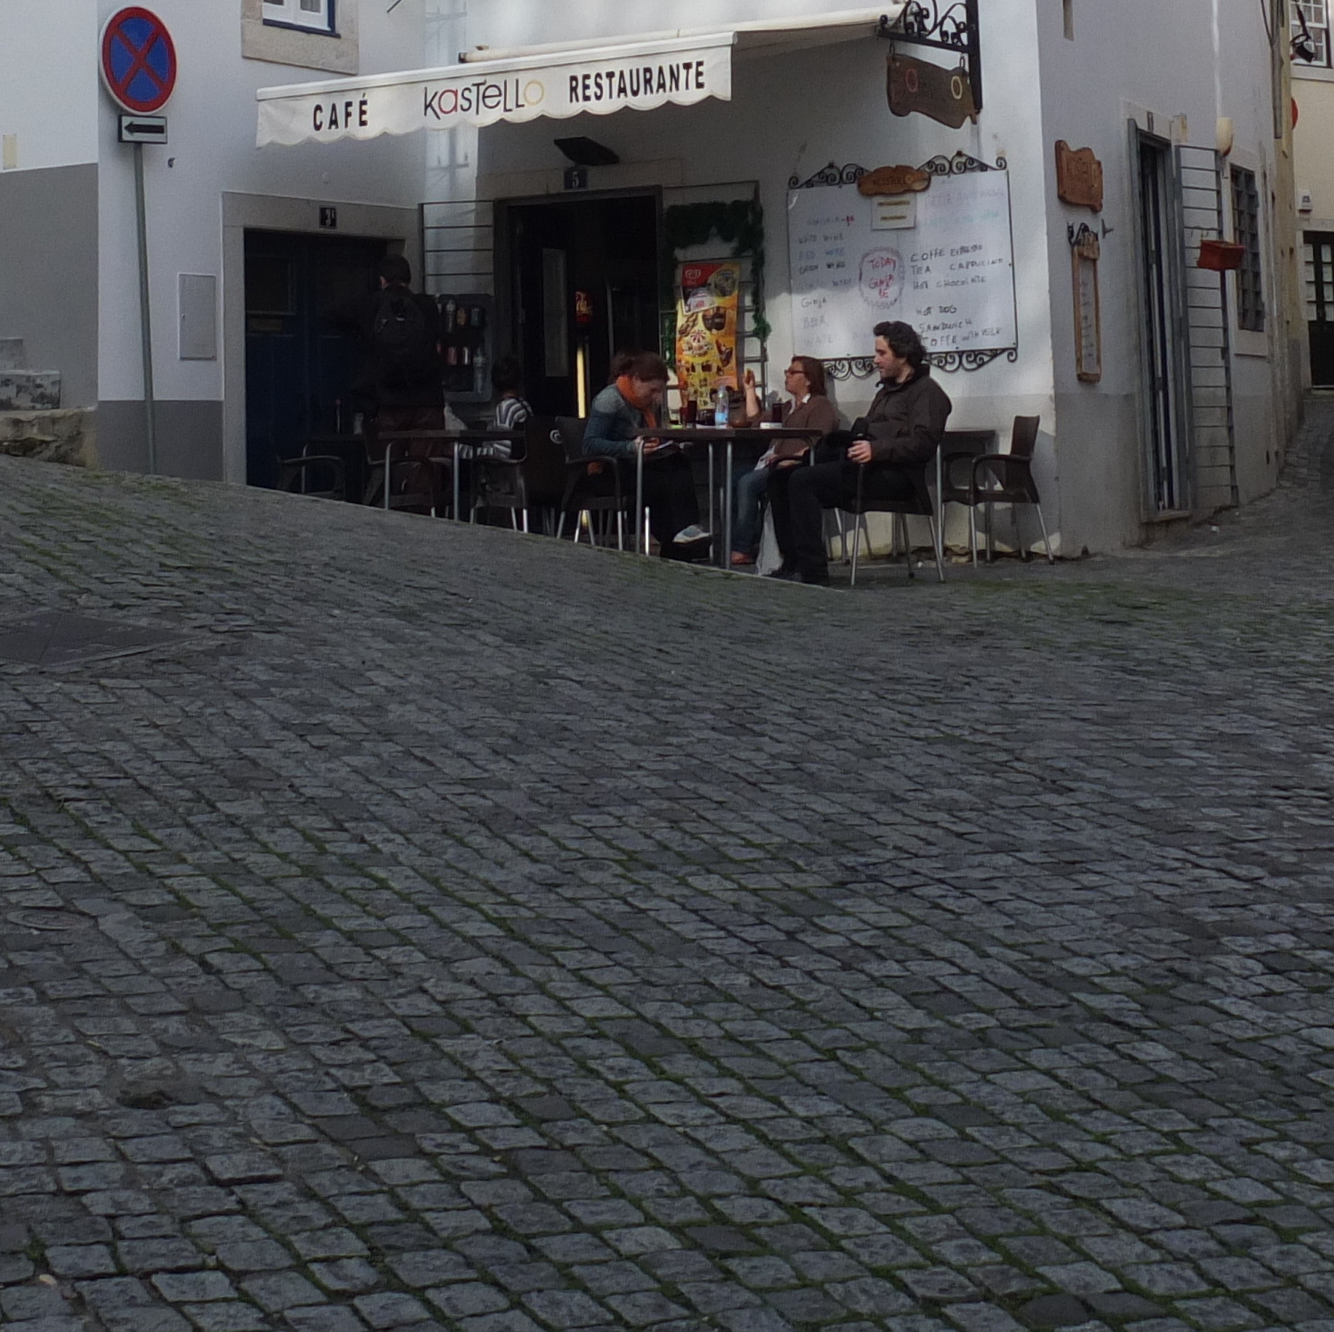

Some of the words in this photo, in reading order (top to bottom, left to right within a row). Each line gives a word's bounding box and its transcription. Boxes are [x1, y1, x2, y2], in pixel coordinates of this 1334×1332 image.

[313, 93, 368, 132] CAFÉ
[569, 61, 705, 103] RESTAURANTE
[911, 265, 931, 275] TEA
